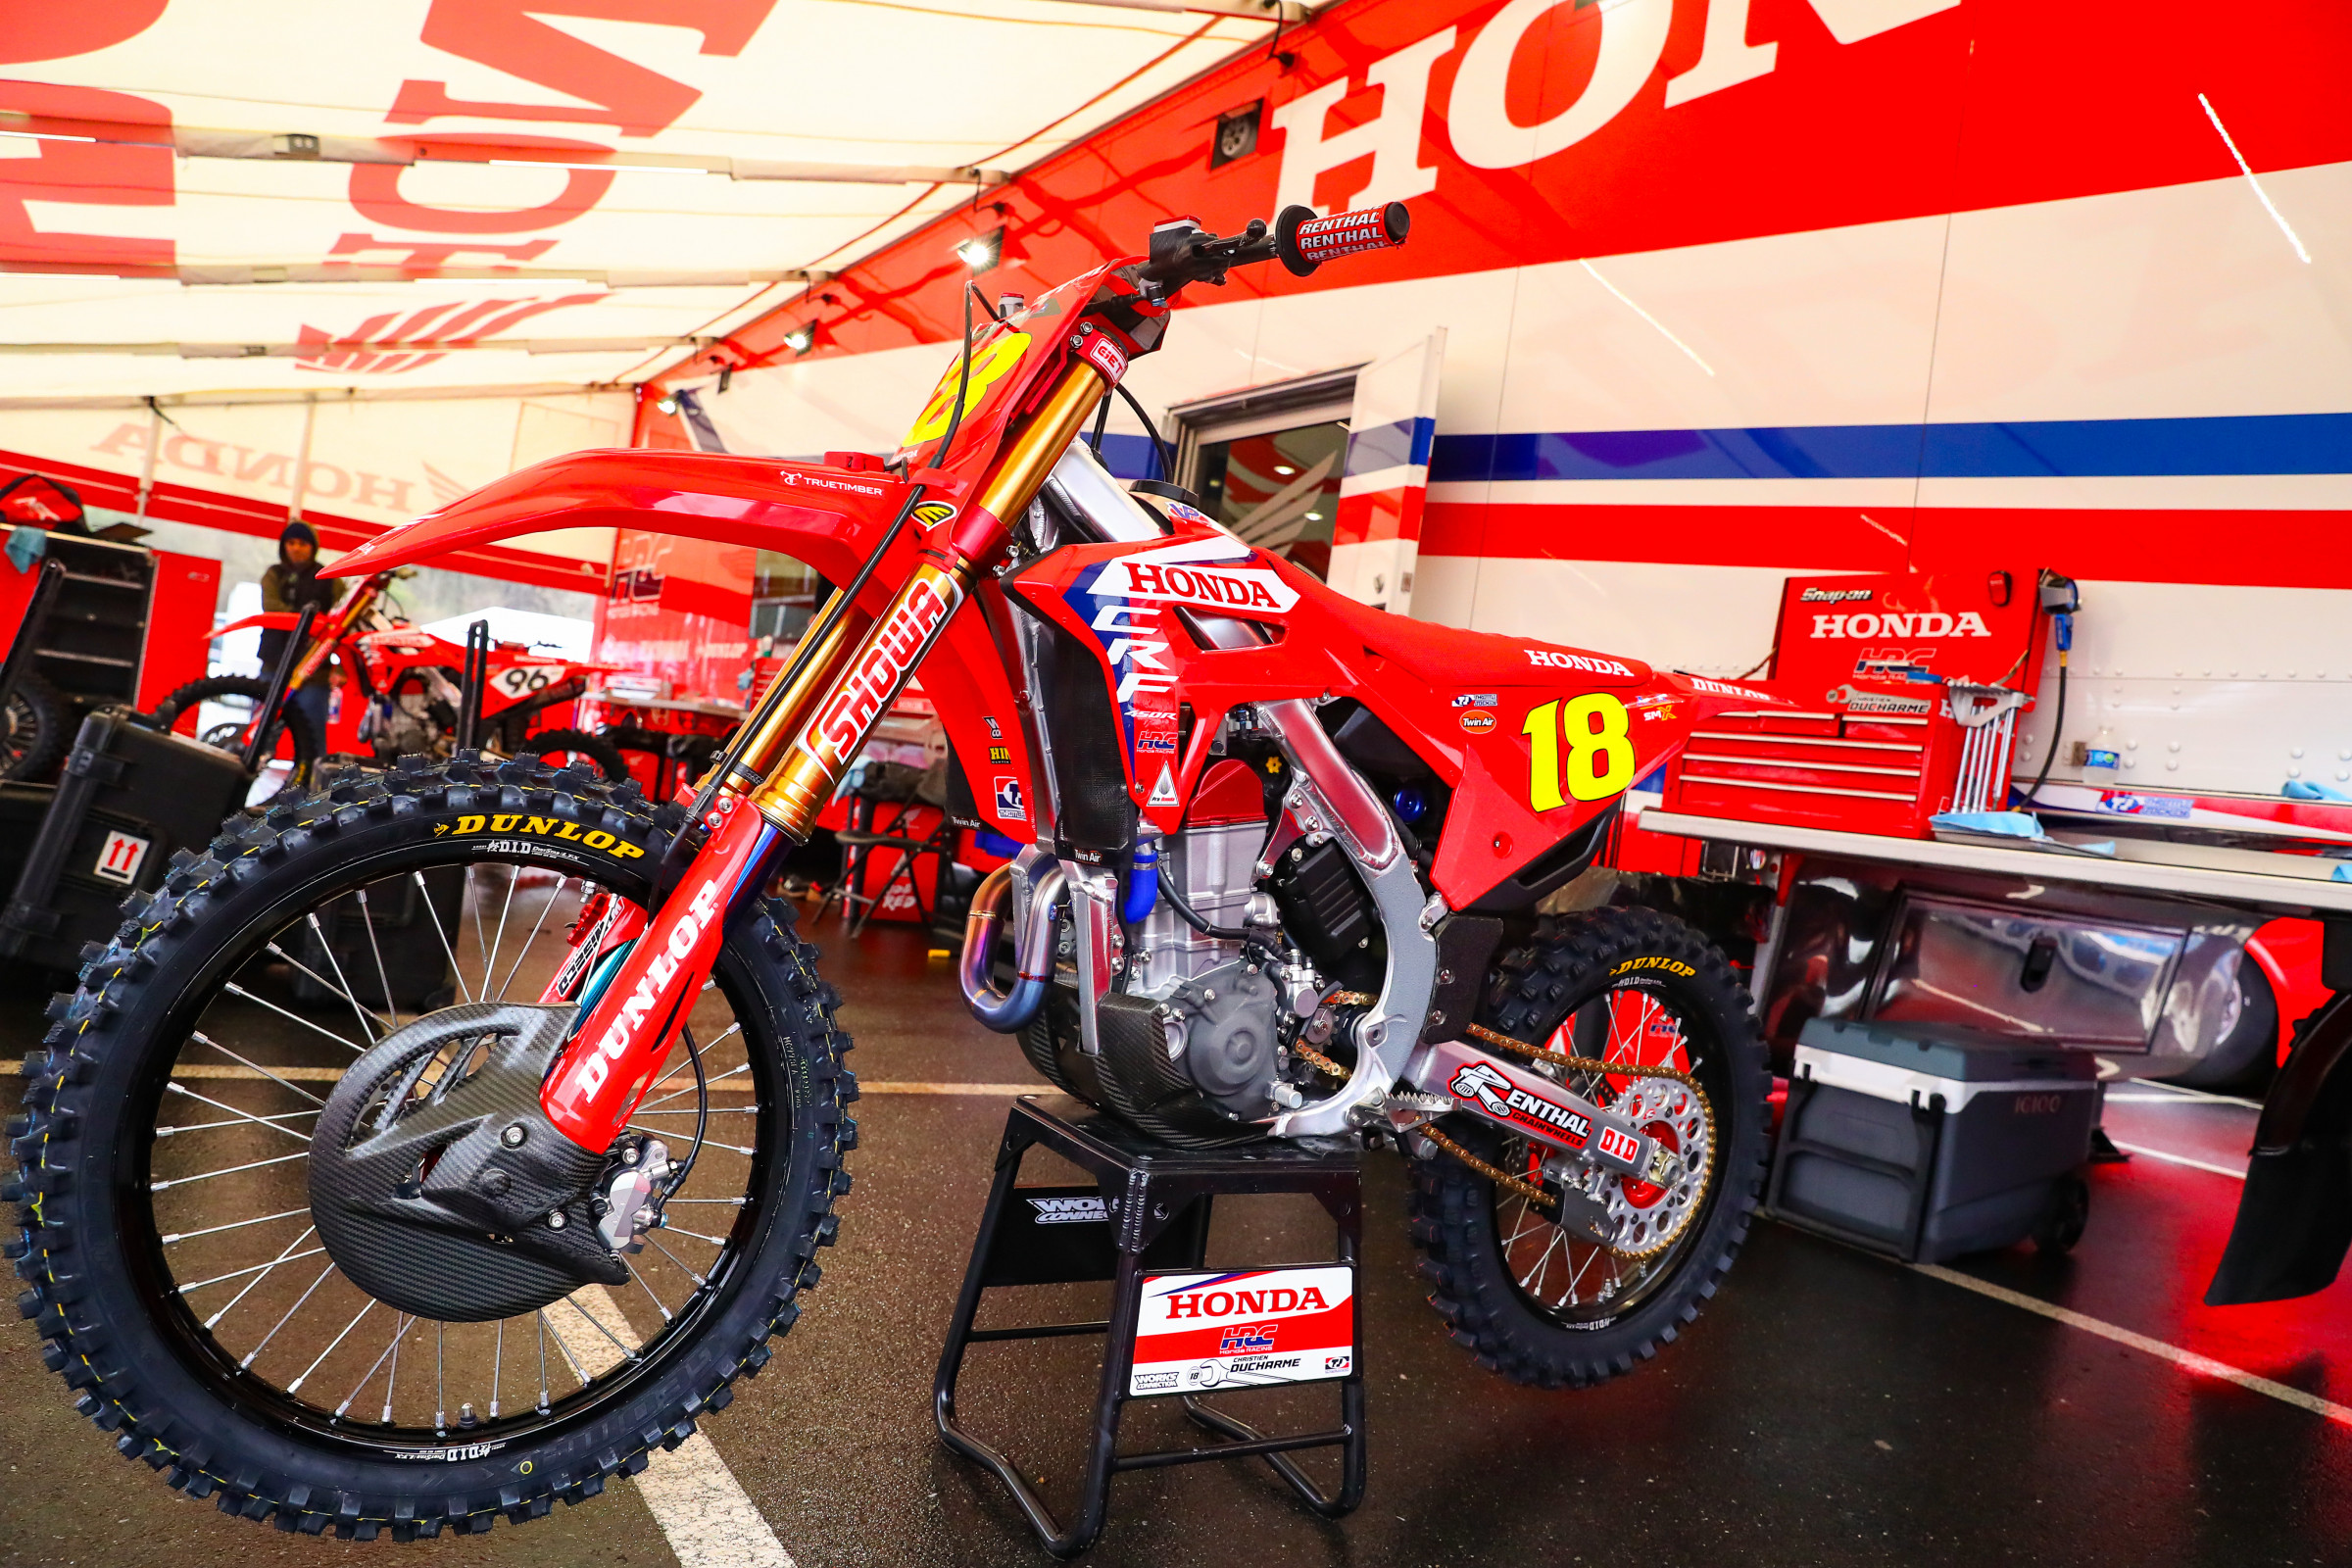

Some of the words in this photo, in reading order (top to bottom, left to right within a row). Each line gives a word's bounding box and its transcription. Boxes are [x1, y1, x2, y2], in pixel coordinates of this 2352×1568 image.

[1298, 212, 1380, 235] RENTHAL
[1300, 226, 1384, 250] RENTHAL
[1098, 344, 1124, 374] GET
[804, 476, 882, 496] TRUETIMBER
[1121, 562, 1281, 609] HONDA
[1800, 587, 1873, 605] Snap-on
[1810, 612, 1992, 639] HONDA
[1091, 604, 1180, 704] CRF
[1524, 649, 1635, 677] HONDA
[506, 667, 549, 695] 96
[819, 578, 948, 764] SHOWA
[1123, 710, 1178, 720] 450R
[1643, 705, 1677, 721] SMX
[1849, 702, 1930, 713] DUCHARME
[1463, 717, 1482, 727] Twin
[1482, 717, 1494, 726] Air
[1137, 731, 1179, 751] HRC
[1521, 692, 1636, 812] 18
[951, 815, 968, 826] Twin
[969, 819, 981, 828] Air
[452, 813, 646, 860] DUNLOP
[499, 840, 531, 855] D.I.D
[1074, 849, 1090, 860] Twin
[1089, 851, 1102, 863] Air
[1615, 956, 1696, 977] DUNLOP
[576, 880, 717, 1104] DUNLOP
[1450, 1061, 1590, 1138] RENTHAL
[1512, 1111, 1584, 1147] CHAINWHEELS
[1601, 1127, 1638, 1160] D.I.D
[1038, 1210, 1108, 1221] CONNE
[1166, 1287, 1329, 1319] HONDA
[1219, 1324, 1278, 1349] HRC
[1230, 1358, 1301, 1373] DUCHARME
[1332, 1358, 1344, 1368] TJ
[1135, 1372, 1179, 1383] WORKS
